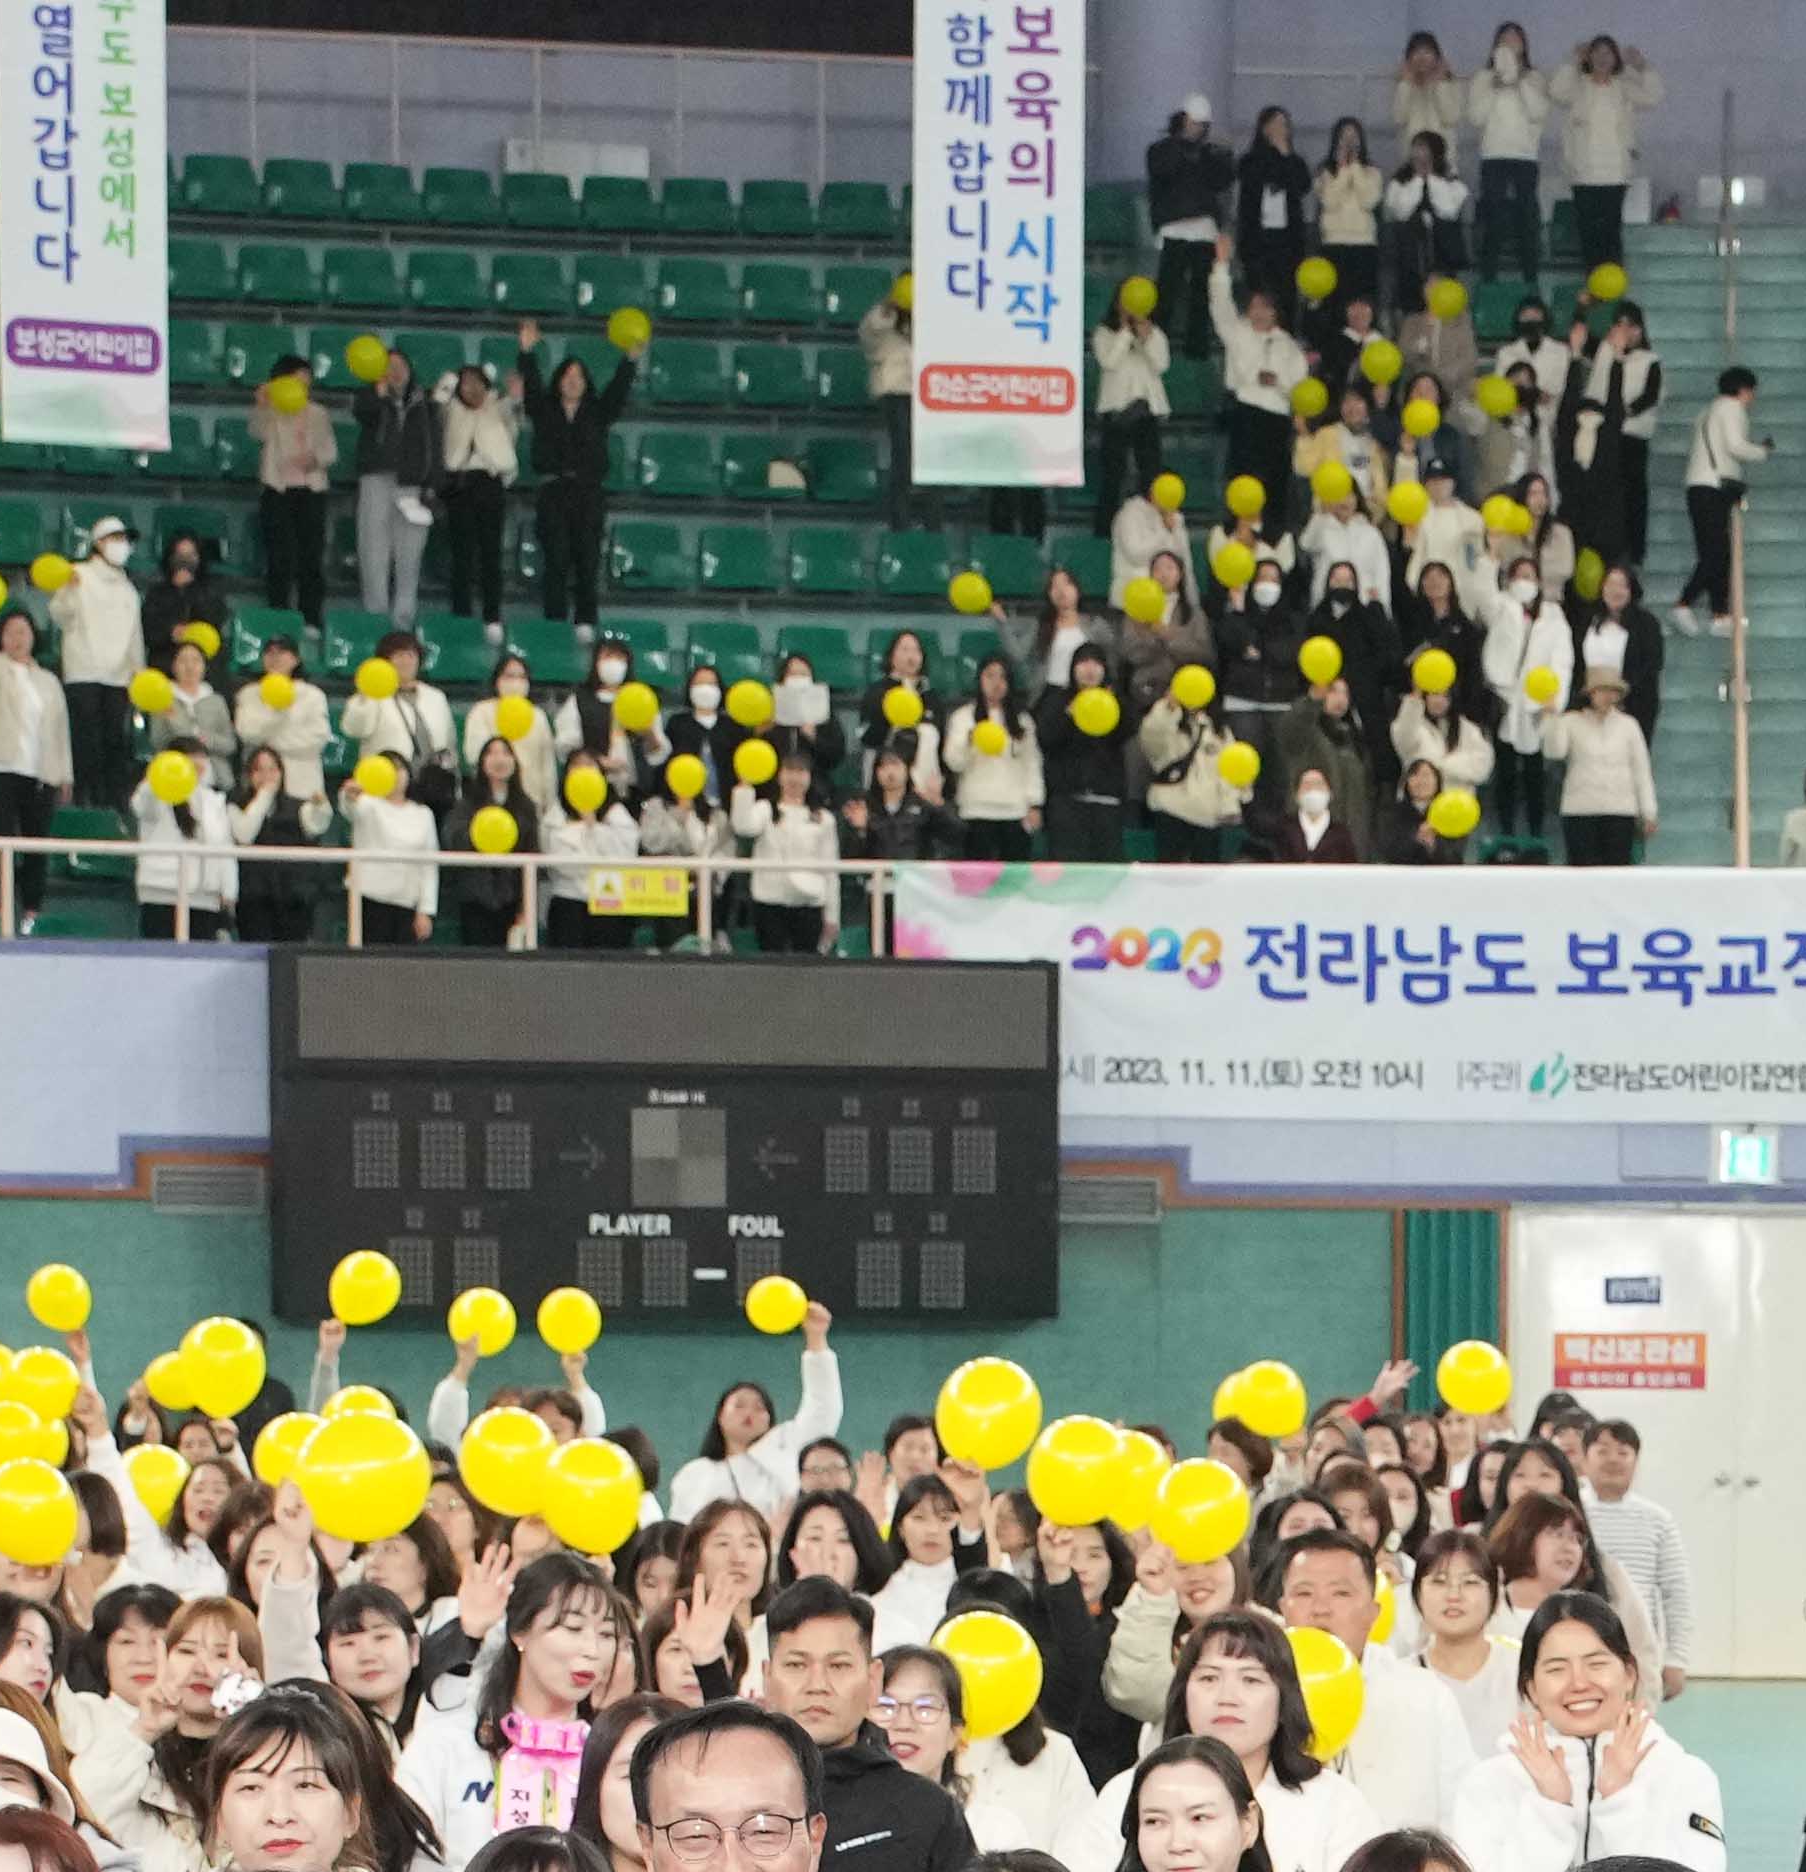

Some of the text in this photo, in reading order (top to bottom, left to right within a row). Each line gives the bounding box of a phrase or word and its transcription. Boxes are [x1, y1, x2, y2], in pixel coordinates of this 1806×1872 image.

[33, 3, 80, 284] 열어갑니다
[98, 82, 138, 259] 보성에서
[945, 13, 993, 311] 함께 합니다
[1006, 6, 1061, 343] 보육의 시작
[13, 324, 154, 368] 보성군어린이집
[927, 370, 1068, 407] 화순군어린이집
[1069, 925, 1224, 990] 2023
[1246, 923, 1536, 1006] 전라남도
[1311, 1057, 1363, 1089] 오전
[1371, 1059, 1426, 1089] 10시
[588, 1213, 785, 1239] PLAYER FOUL
